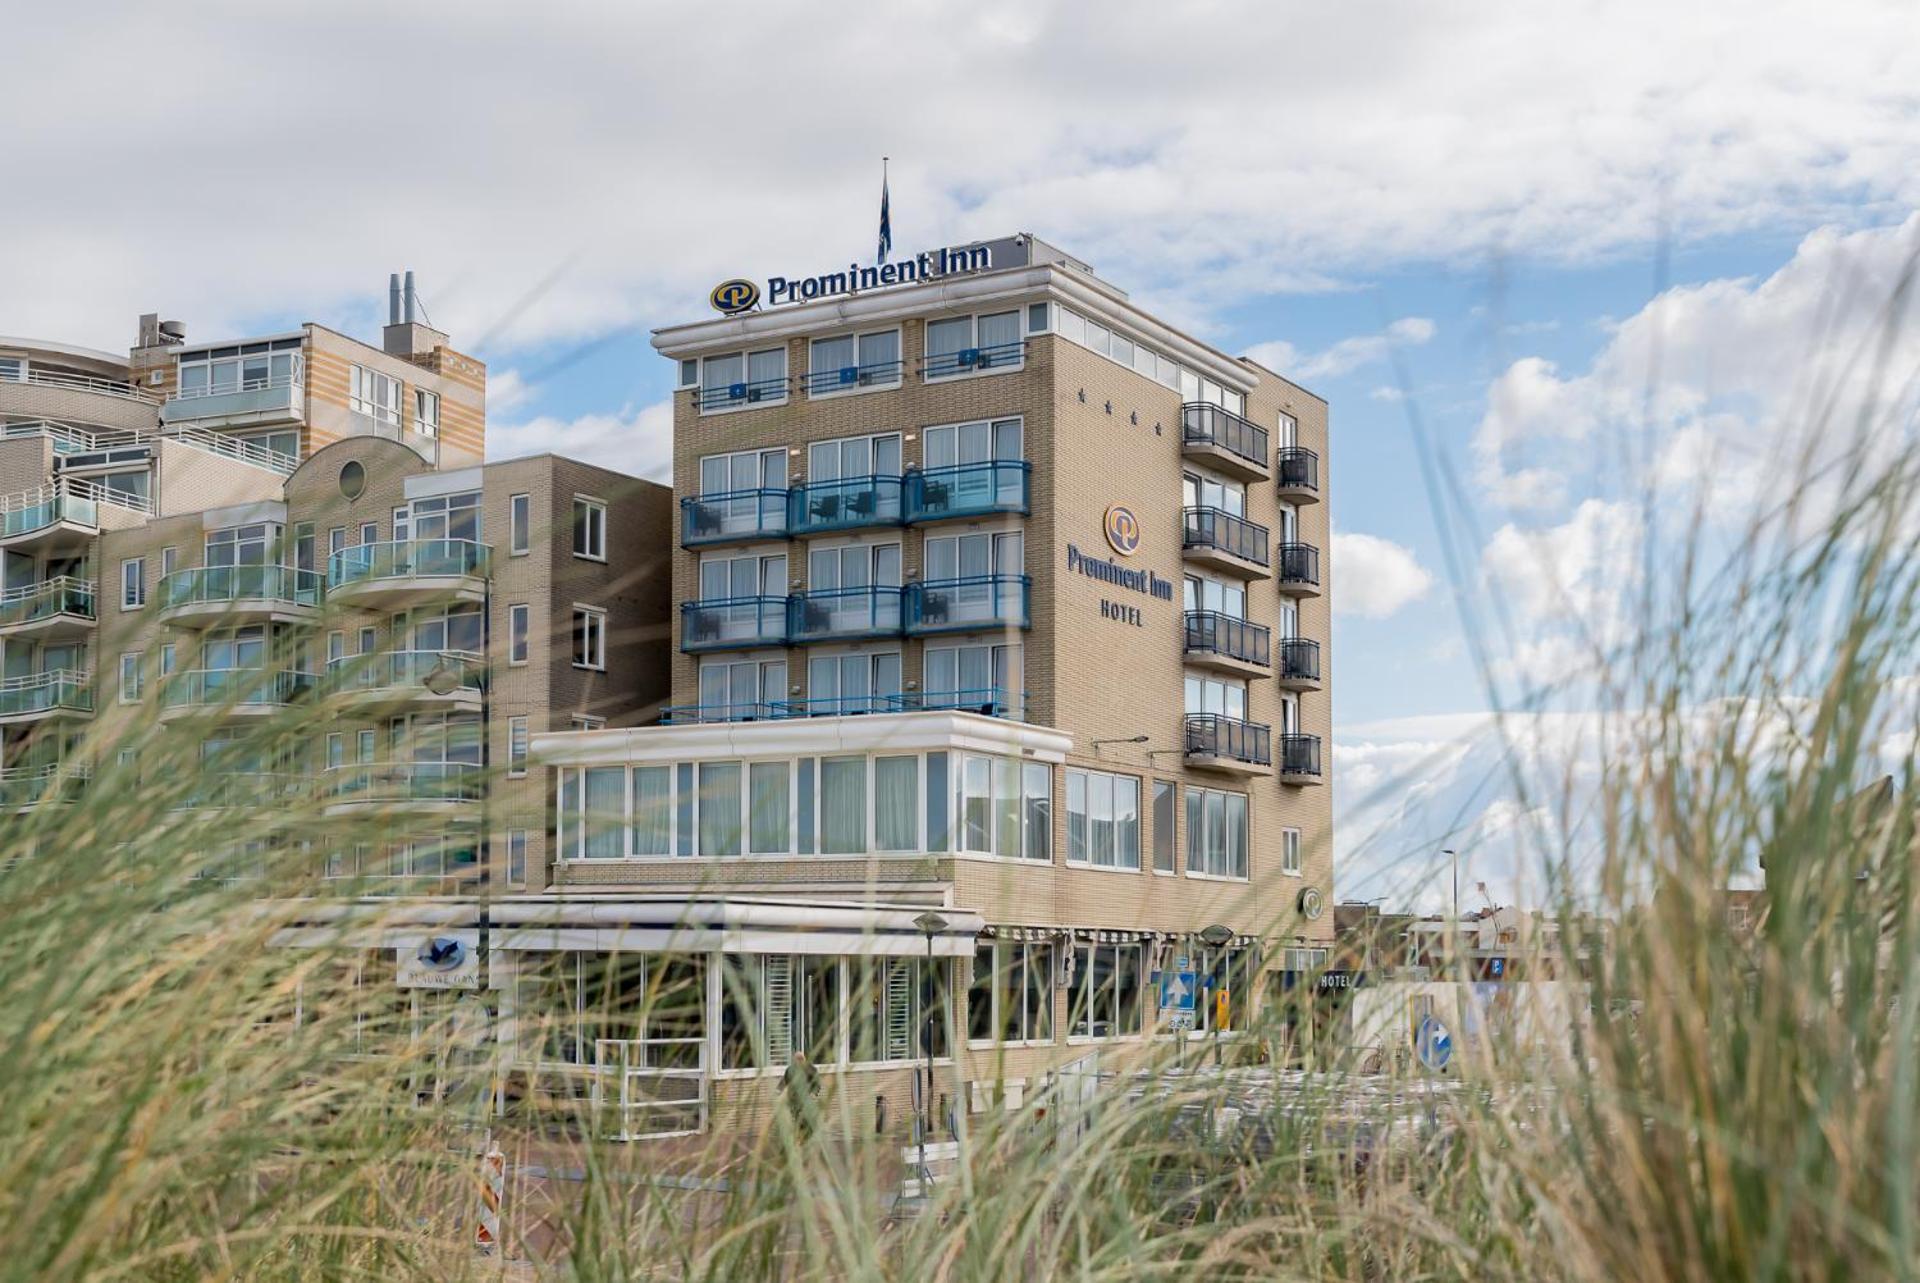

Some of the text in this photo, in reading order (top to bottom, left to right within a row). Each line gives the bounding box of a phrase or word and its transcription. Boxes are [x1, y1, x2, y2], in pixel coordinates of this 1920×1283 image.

[768, 246, 992, 305] Prominent Inn
[1067, 543, 1173, 601] Prominent Inn
[1101, 598, 1142, 627] HOTEL
[1321, 975, 1350, 987] HOTEL
